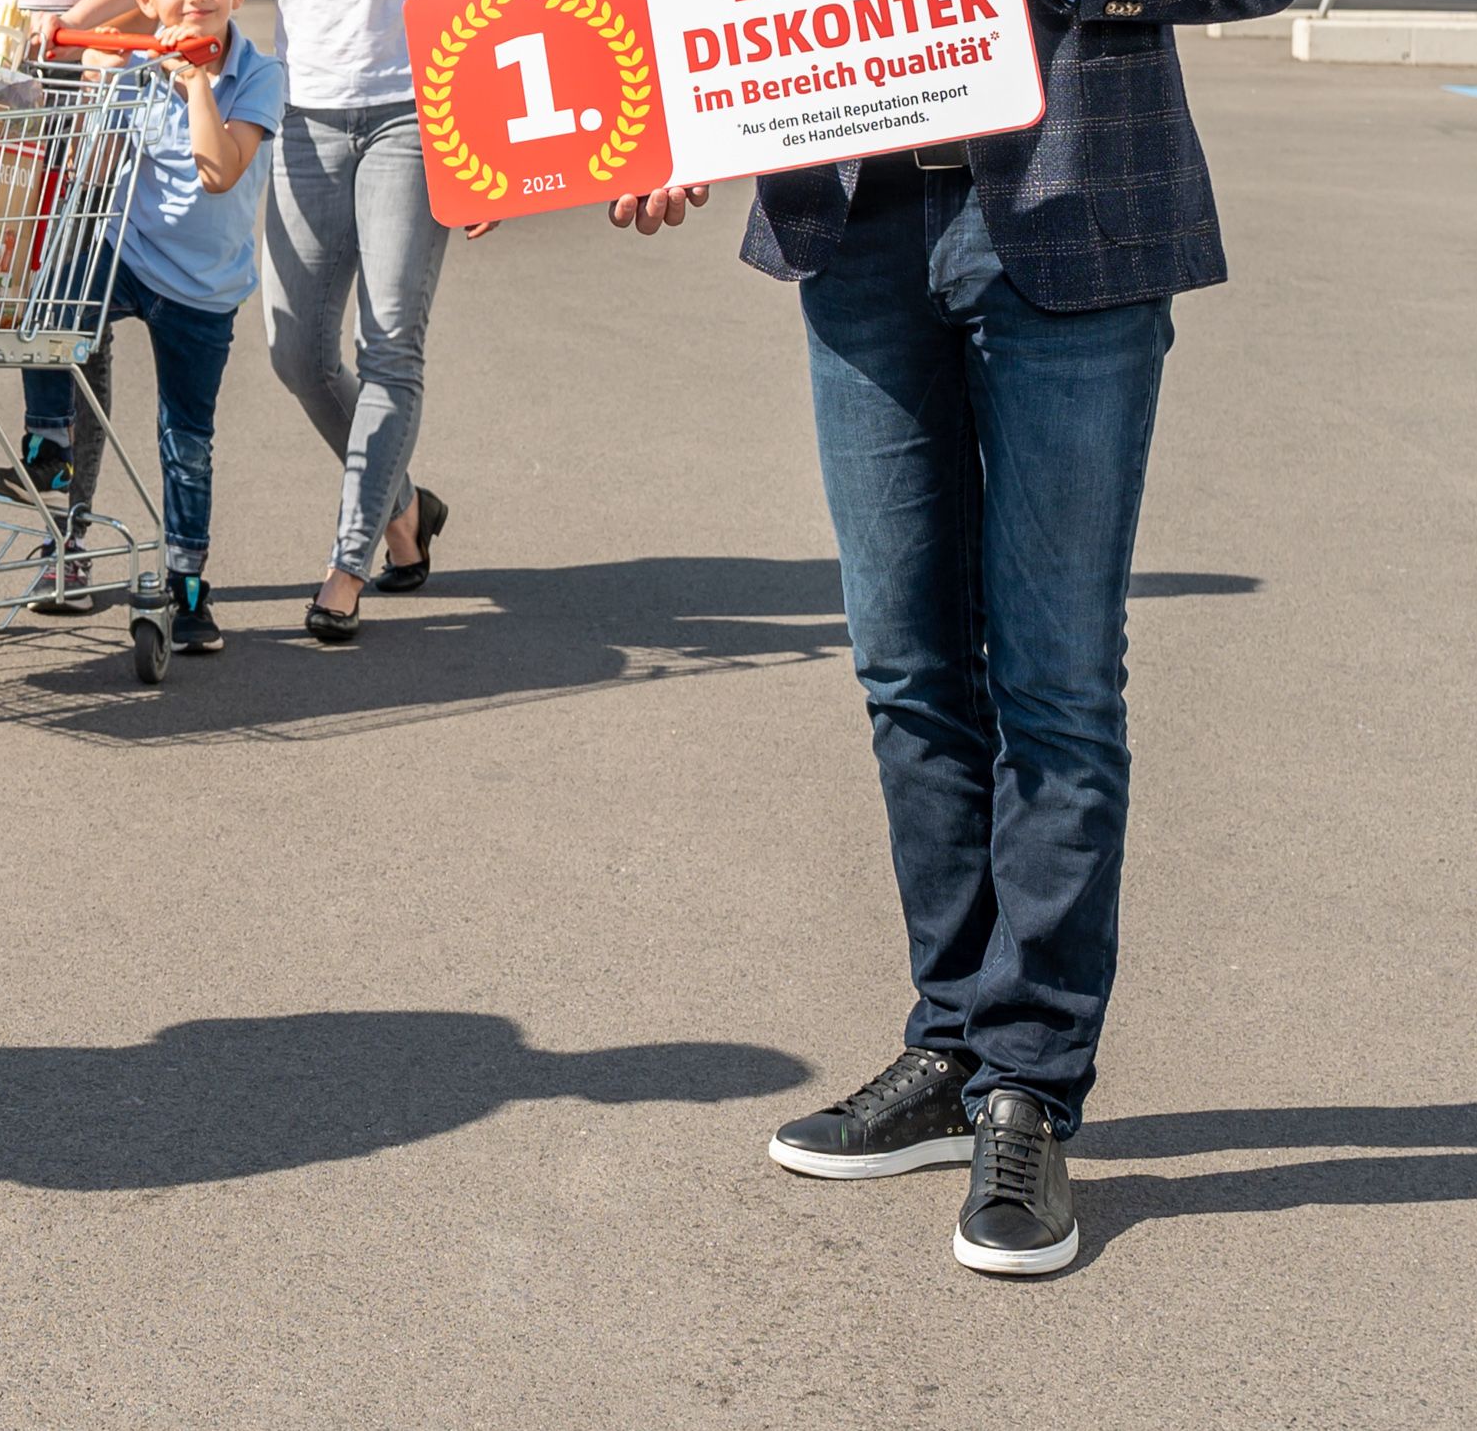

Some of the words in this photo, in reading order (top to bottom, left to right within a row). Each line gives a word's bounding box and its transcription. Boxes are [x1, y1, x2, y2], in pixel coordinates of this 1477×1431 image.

[494, 32, 603, 144] 1.
[692, 86, 734, 113] im
[740, 64, 857, 105] Bereich
[768, 113, 799, 131] dem
[802, 107, 842, 126] Retail
[844, 94, 920, 118] Reputation
[921, 84, 969, 106] Report
[782, 131, 806, 147] des
[808, 110, 930, 142] Handelsverbands.
[522, 173, 567, 195] 2021
